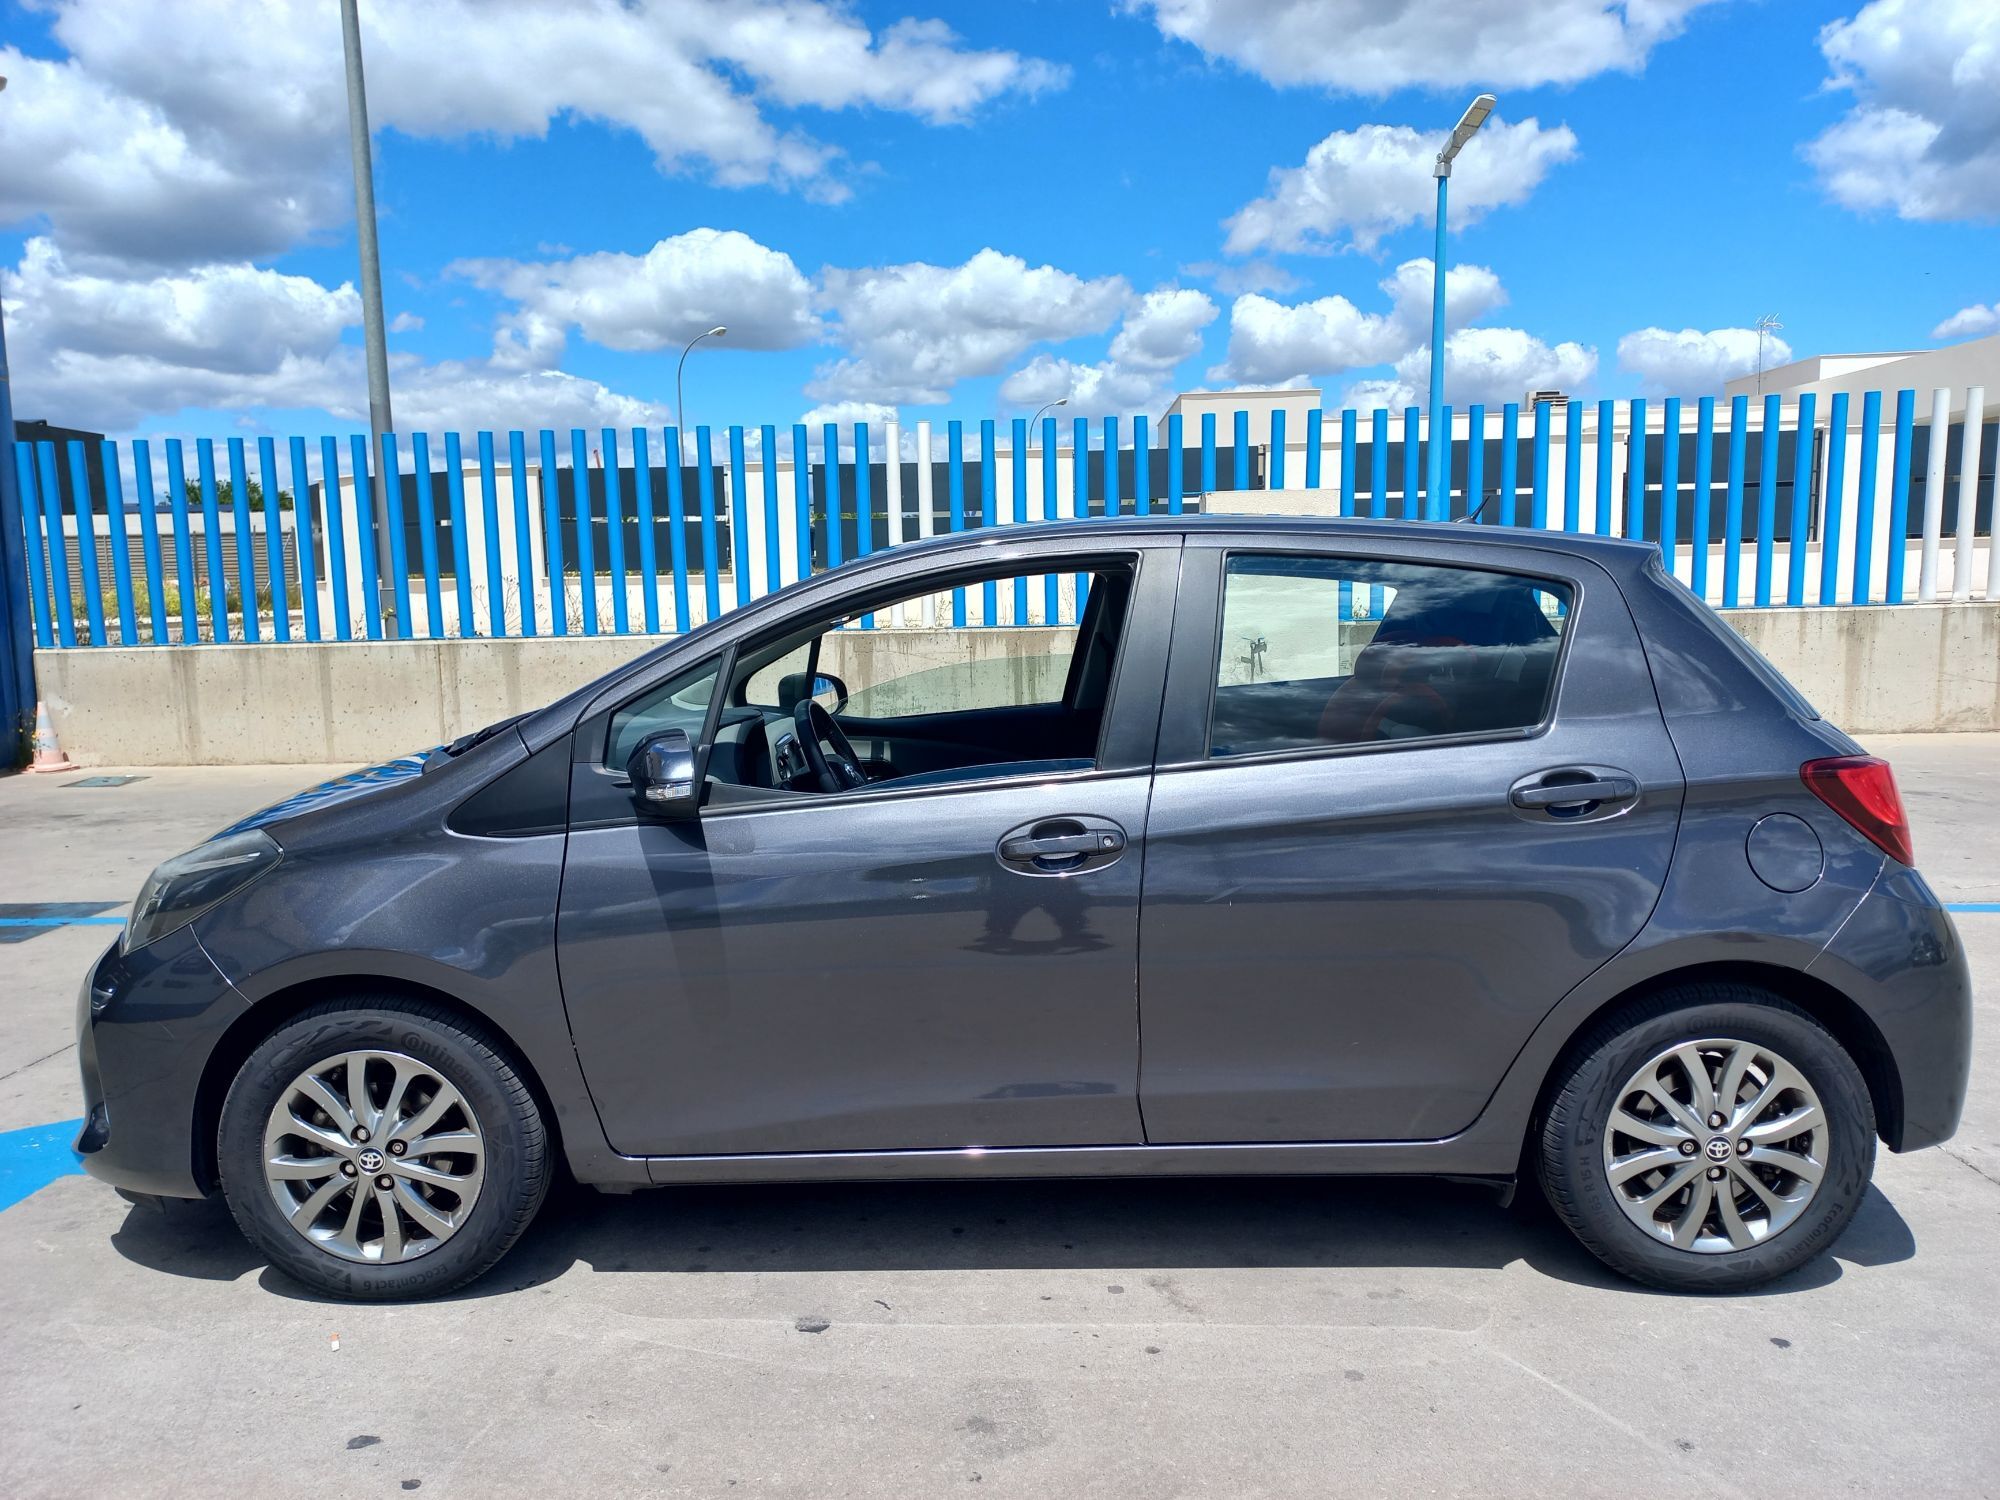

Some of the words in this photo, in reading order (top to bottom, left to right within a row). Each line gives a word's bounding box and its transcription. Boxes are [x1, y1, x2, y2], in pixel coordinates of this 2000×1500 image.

[400, 1031, 493, 1102] Continental
[1580, 1156, 1591, 1166] H
[1580, 1169, 1593, 1182] 15
[1584, 1183, 1595, 1192] R
[1785, 1202, 1844, 1260] EcoContact
[1775, 1255, 1786, 1266] 6
[374, 1263, 449, 1291] EcoContact
[363, 1280, 372, 1291] 6
